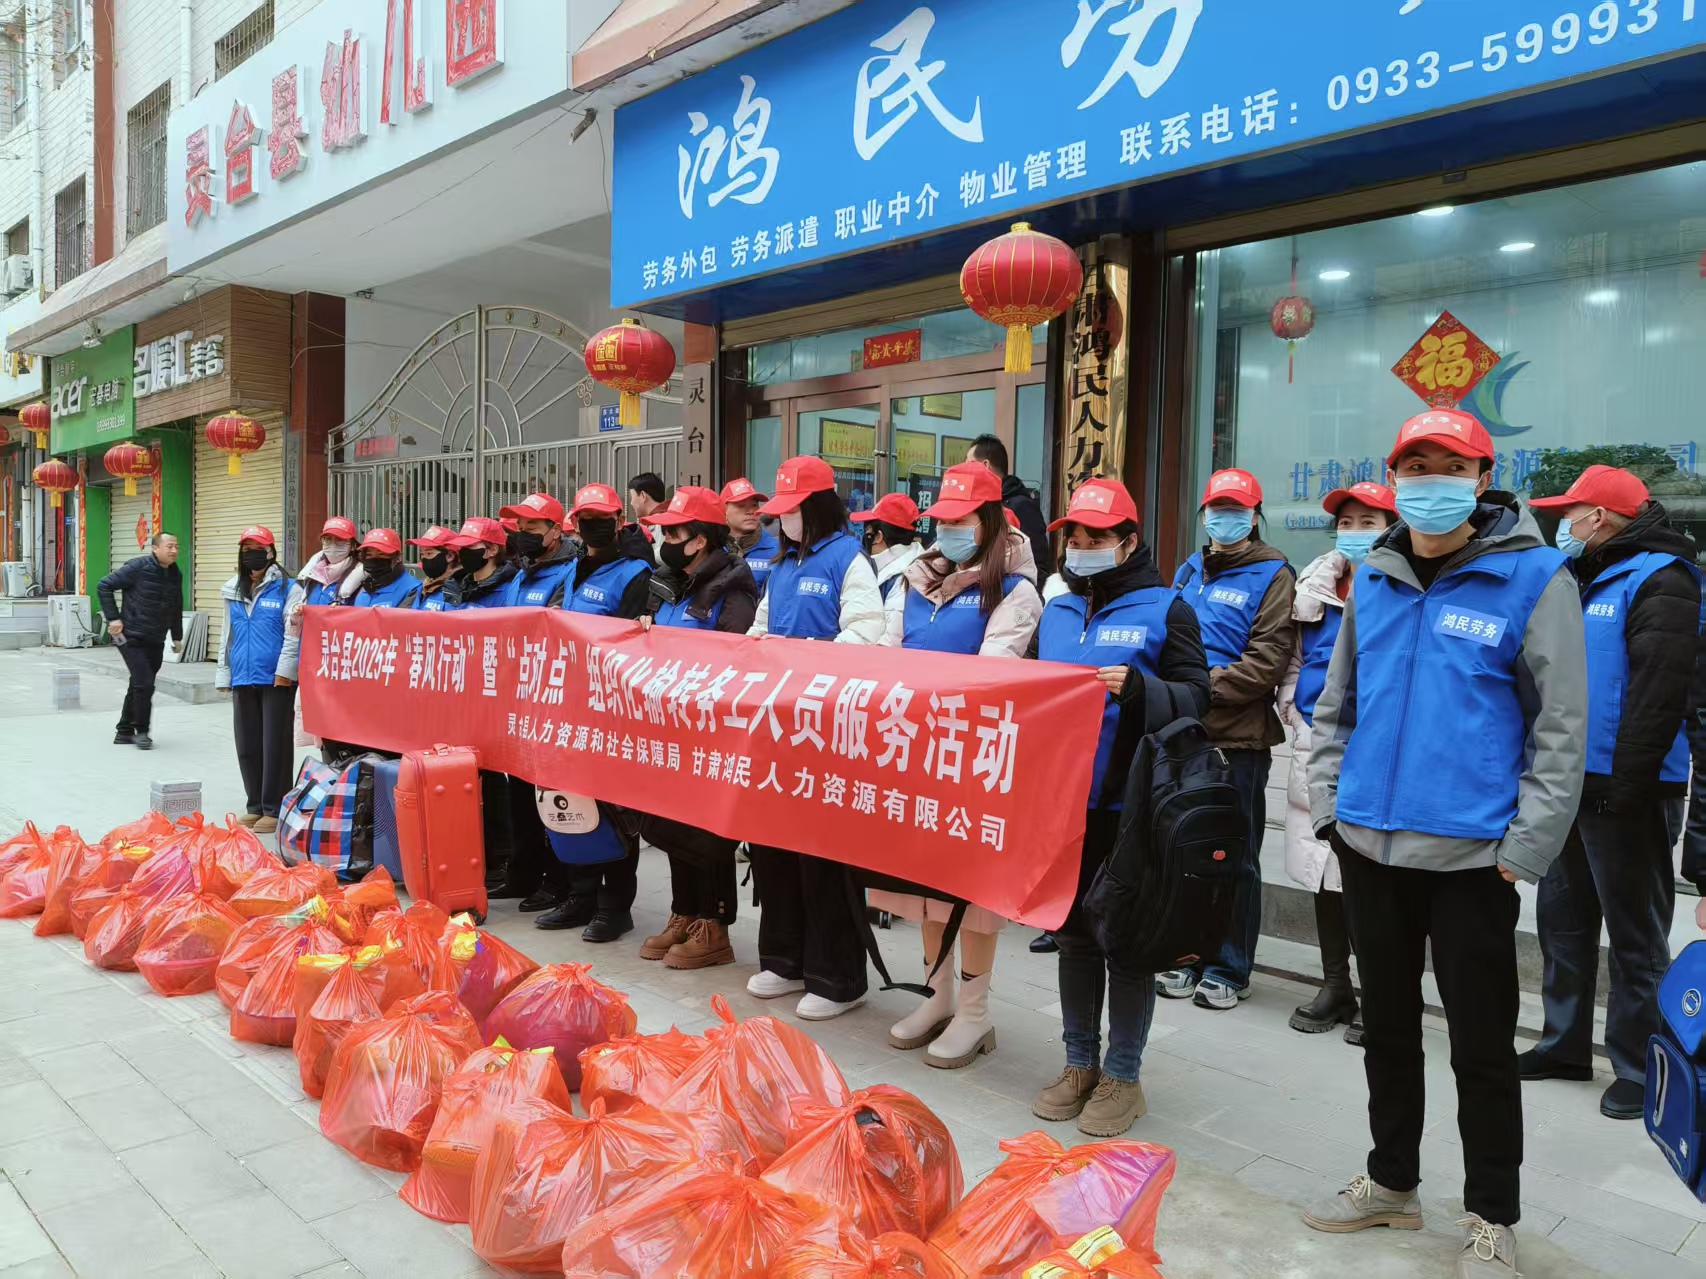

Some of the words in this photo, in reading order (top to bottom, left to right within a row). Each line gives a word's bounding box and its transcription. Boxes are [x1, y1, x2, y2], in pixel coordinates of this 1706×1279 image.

[643, 246, 717, 290] 劳务外包
[731, 215, 819, 268] 劳务派遣
[834, 183, 940, 240] 职业中介
[959, 140, 1087, 208] 物业管理
[1415, 331, 1473, 390] 福
[51, 376, 87, 420] acer
[1285, 512, 1333, 529] Gans
[800, 581, 828, 595] 鸿民劳务
[957, 595, 981, 605] 鸿民劳
[1213, 589, 1244, 605] 鸿民劳务
[1586, 603, 1615, 617] 鸿民劳务
[1441, 613, 1497, 639] 鸿民劳务
[1100, 630, 1141, 644] 鸿民劳务
[692, 746, 1006, 852] 甘肃鸿民人力资源有限公司
